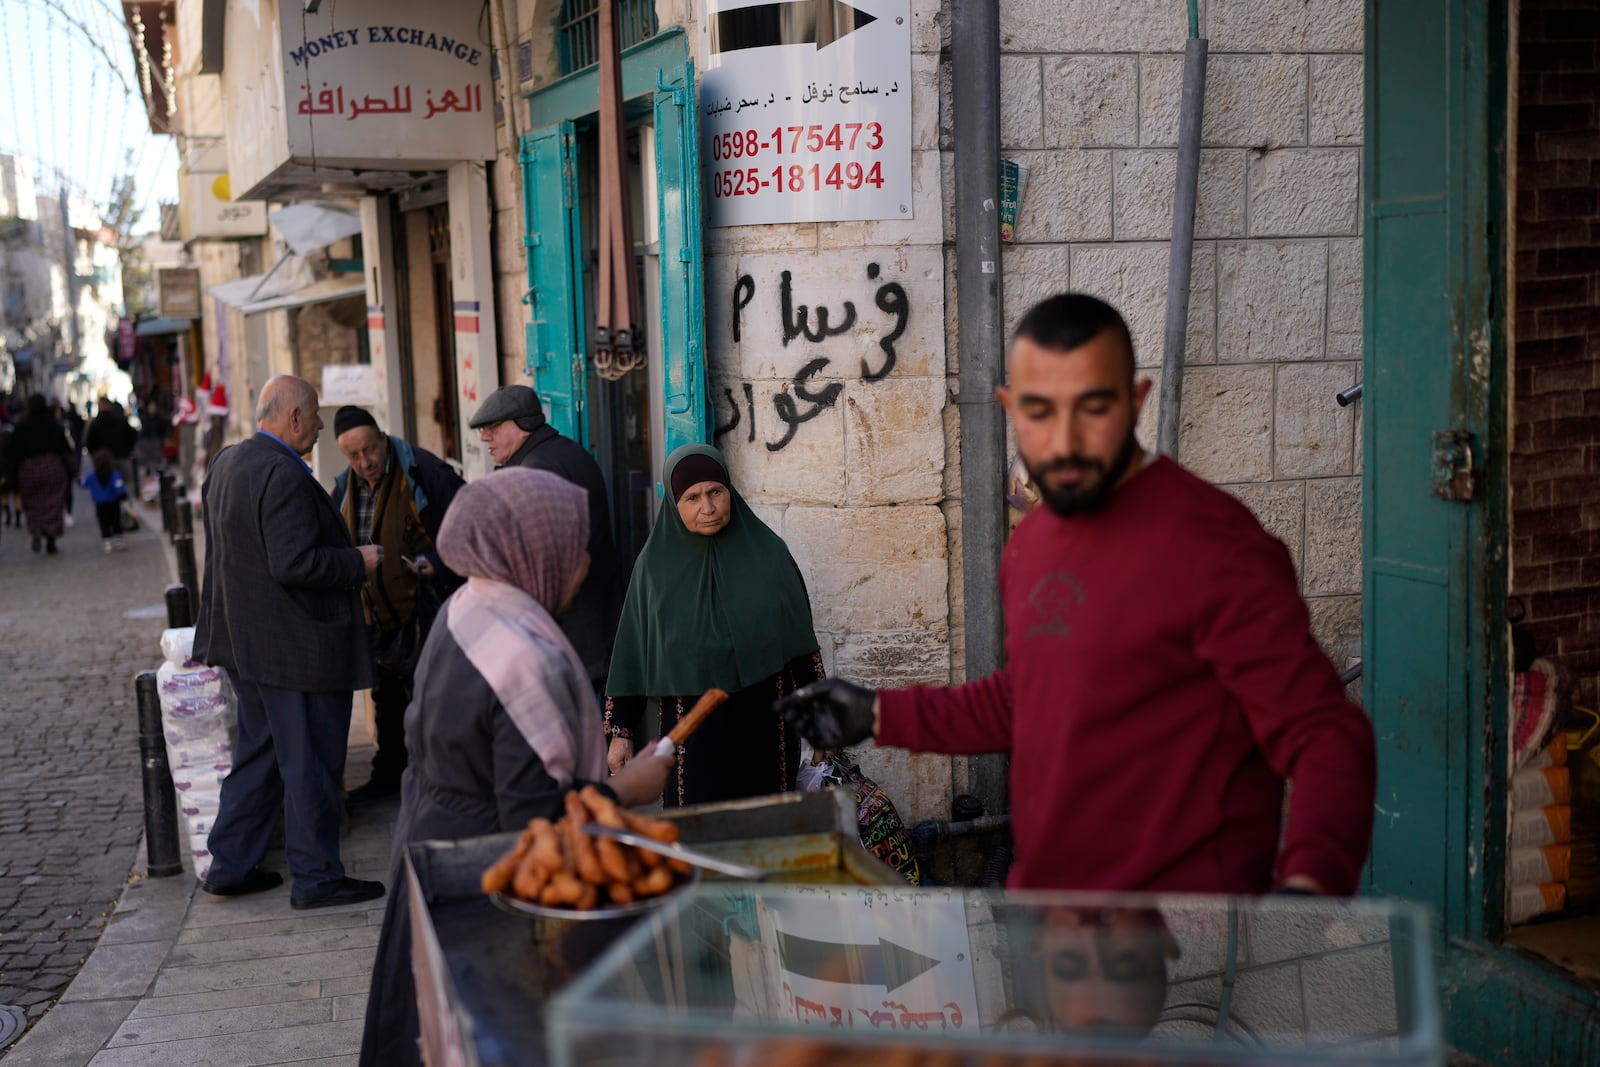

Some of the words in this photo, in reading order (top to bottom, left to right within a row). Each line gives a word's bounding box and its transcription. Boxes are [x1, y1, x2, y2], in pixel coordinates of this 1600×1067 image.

[289, 28, 359, 66] MONEY
[368, 26, 482, 66] EXCHANGE
[298, 81, 412, 120] للصرافة
[423, 83, 482, 119] العز
[735, 95, 758, 114] سحر
[802, 82, 833, 104] نوفل
[839, 81, 878, 104] سامح
[713, 121, 884, 161] 0598-175473
[714, 161, 885, 199] 0525-181494
